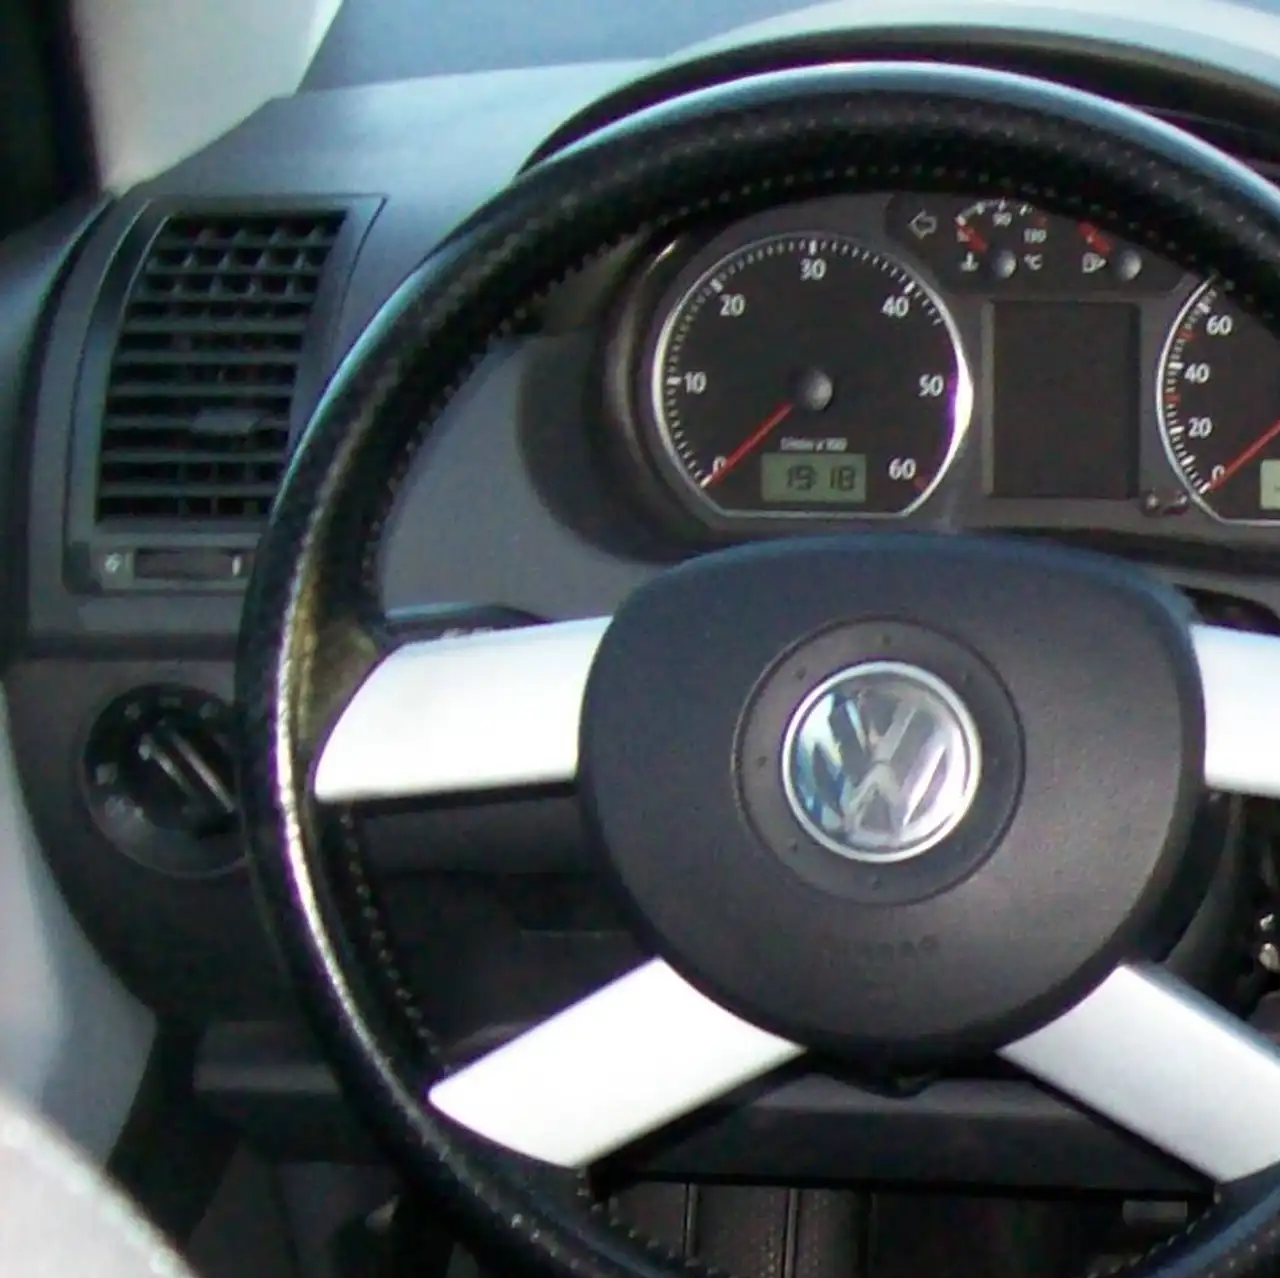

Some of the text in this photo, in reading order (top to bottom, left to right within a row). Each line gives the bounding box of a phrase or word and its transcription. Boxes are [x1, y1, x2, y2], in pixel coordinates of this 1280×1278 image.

[799, 258, 827, 281] 30
[719, 294, 746, 317] 20
[881, 298, 910, 318] 40
[1206, 315, 1234, 336] 60
[683, 372, 707, 394] 10
[1183, 363, 1210, 384] 40
[918, 376, 945, 397] 50
[1187, 418, 1213, 438] 20
[888, 457, 917, 480] 60
